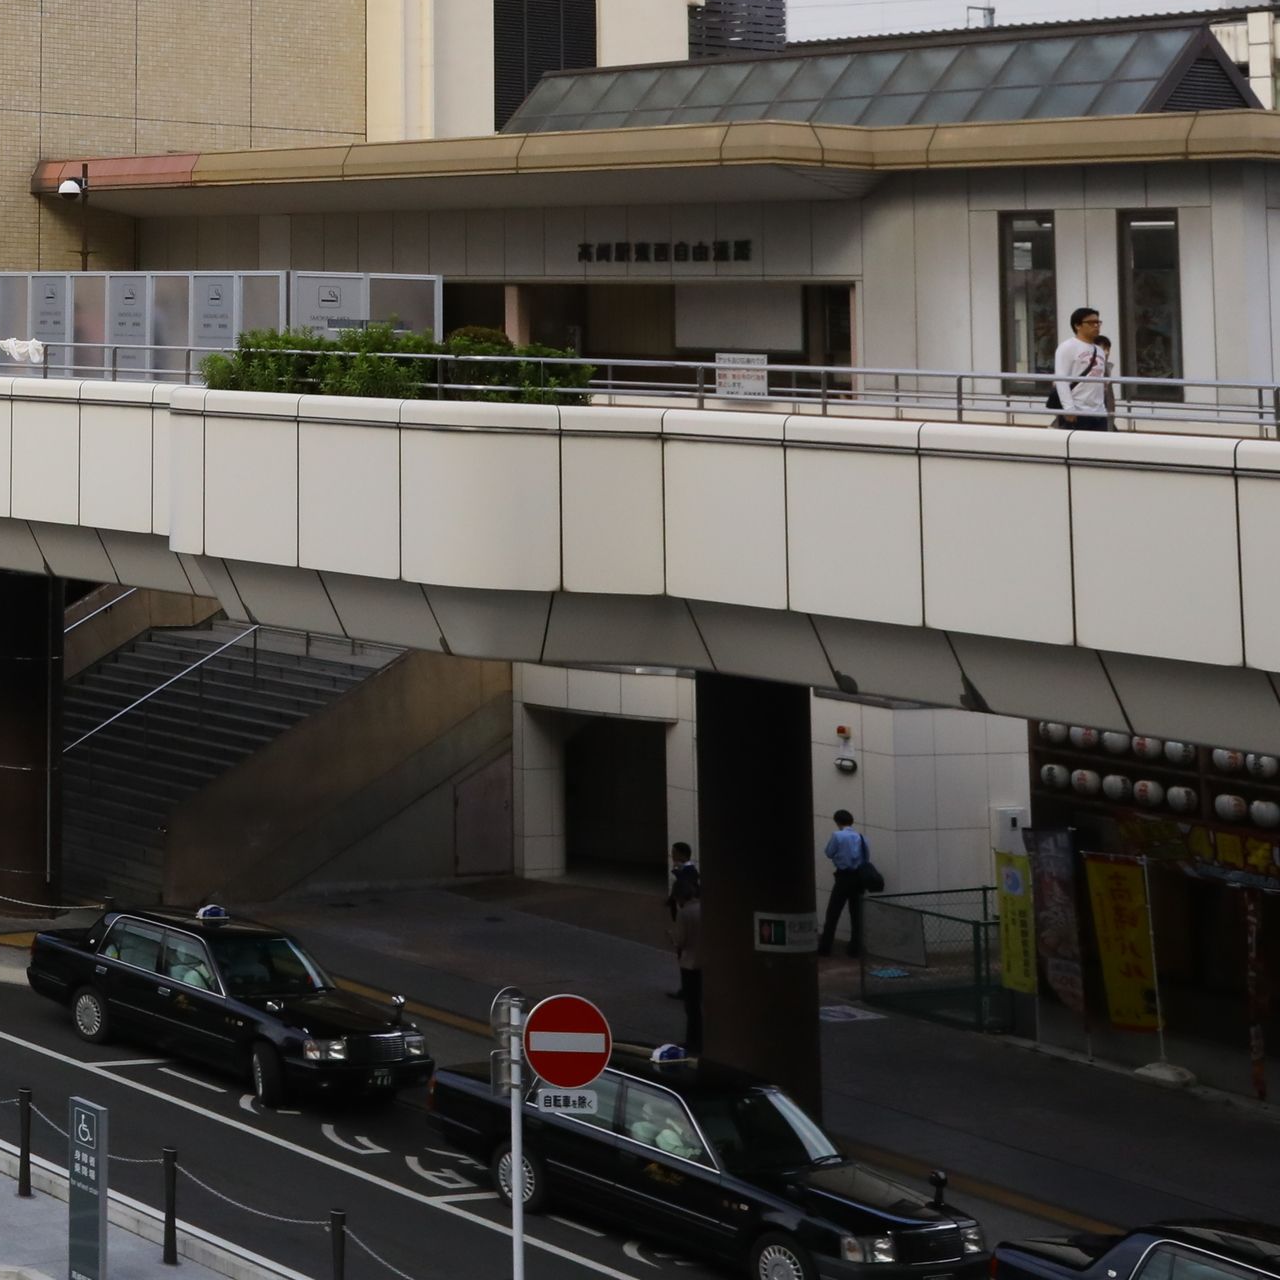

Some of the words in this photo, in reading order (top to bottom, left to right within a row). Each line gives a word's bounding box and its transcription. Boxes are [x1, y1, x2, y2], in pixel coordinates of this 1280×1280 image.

[543, 1094, 594, 1109] 自転車を除く
